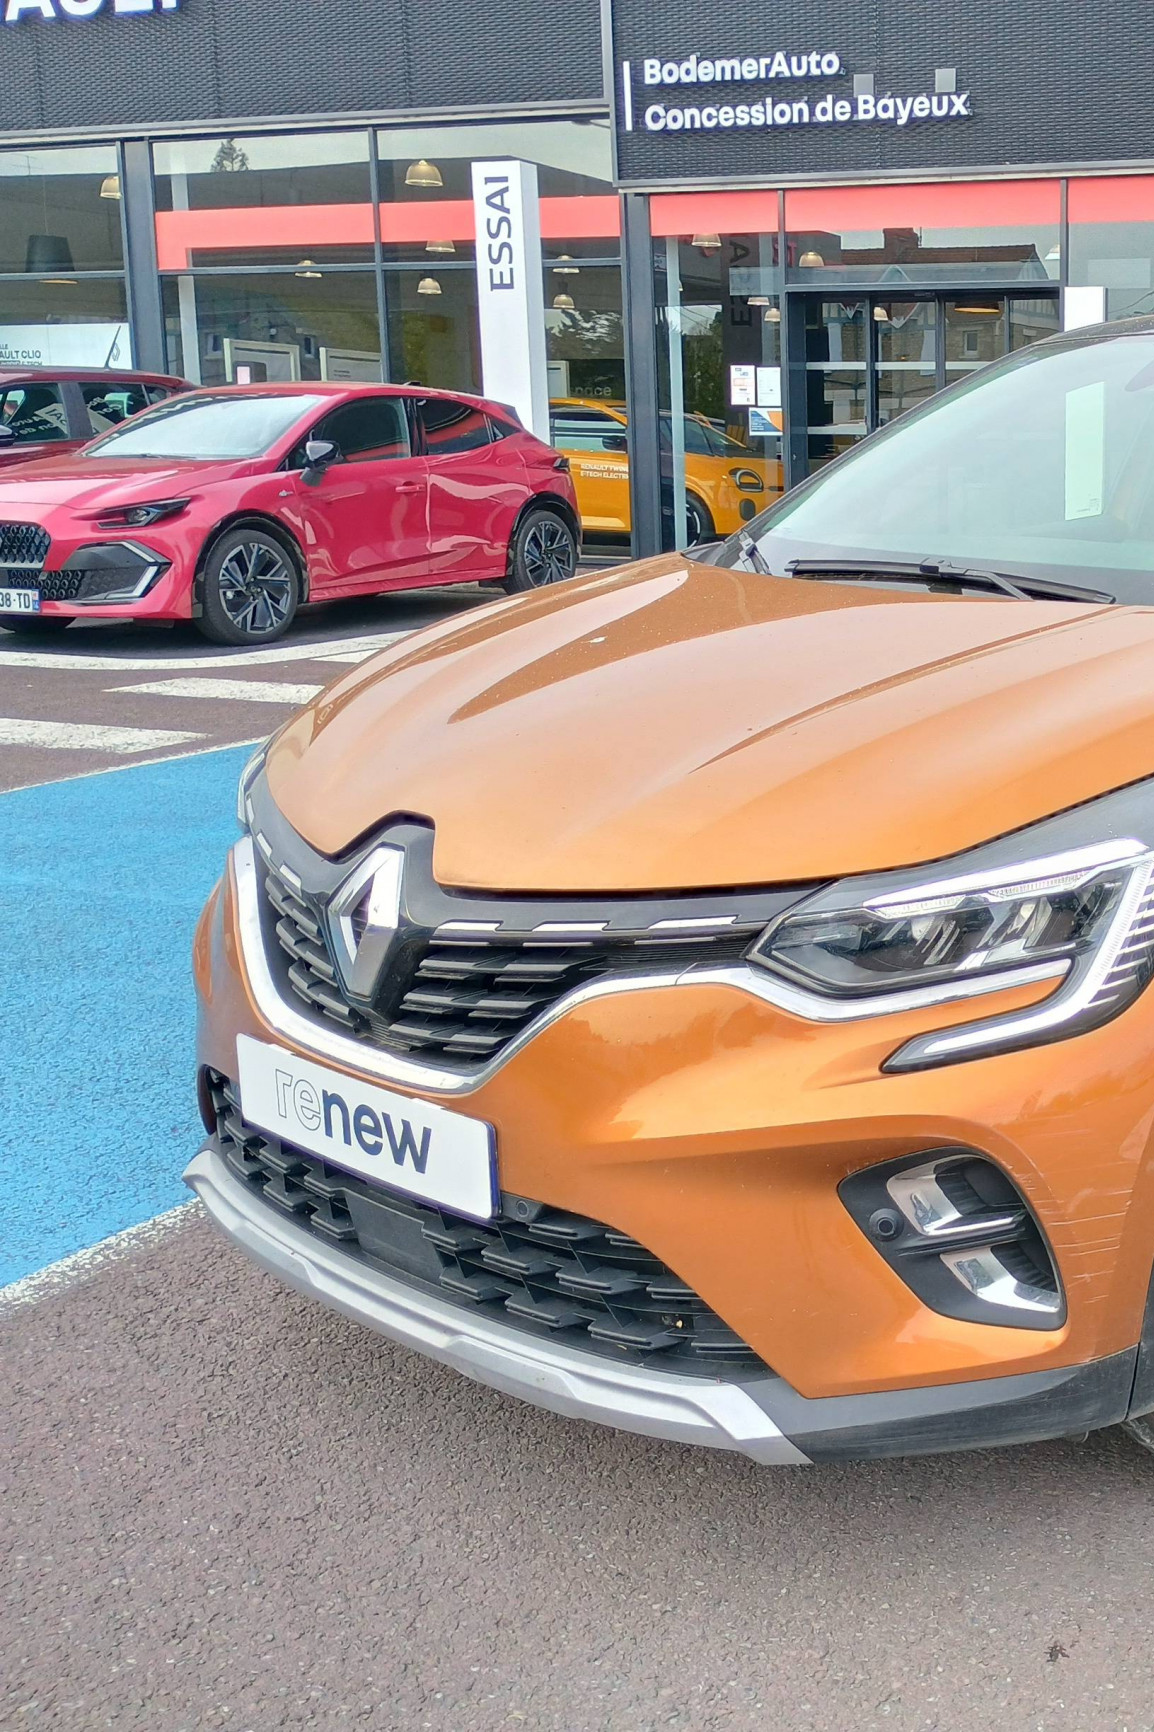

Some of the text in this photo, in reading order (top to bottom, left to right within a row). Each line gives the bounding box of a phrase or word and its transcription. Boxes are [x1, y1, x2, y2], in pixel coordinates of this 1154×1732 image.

[643, 51, 841, 85] BodemerAuto
[644, 93, 970, 131] Concession de Bayeux
[484, 176, 514, 291] ESSAI
[21, 350, 41, 359] CLIO
[275, 1069, 432, 1174] renew
